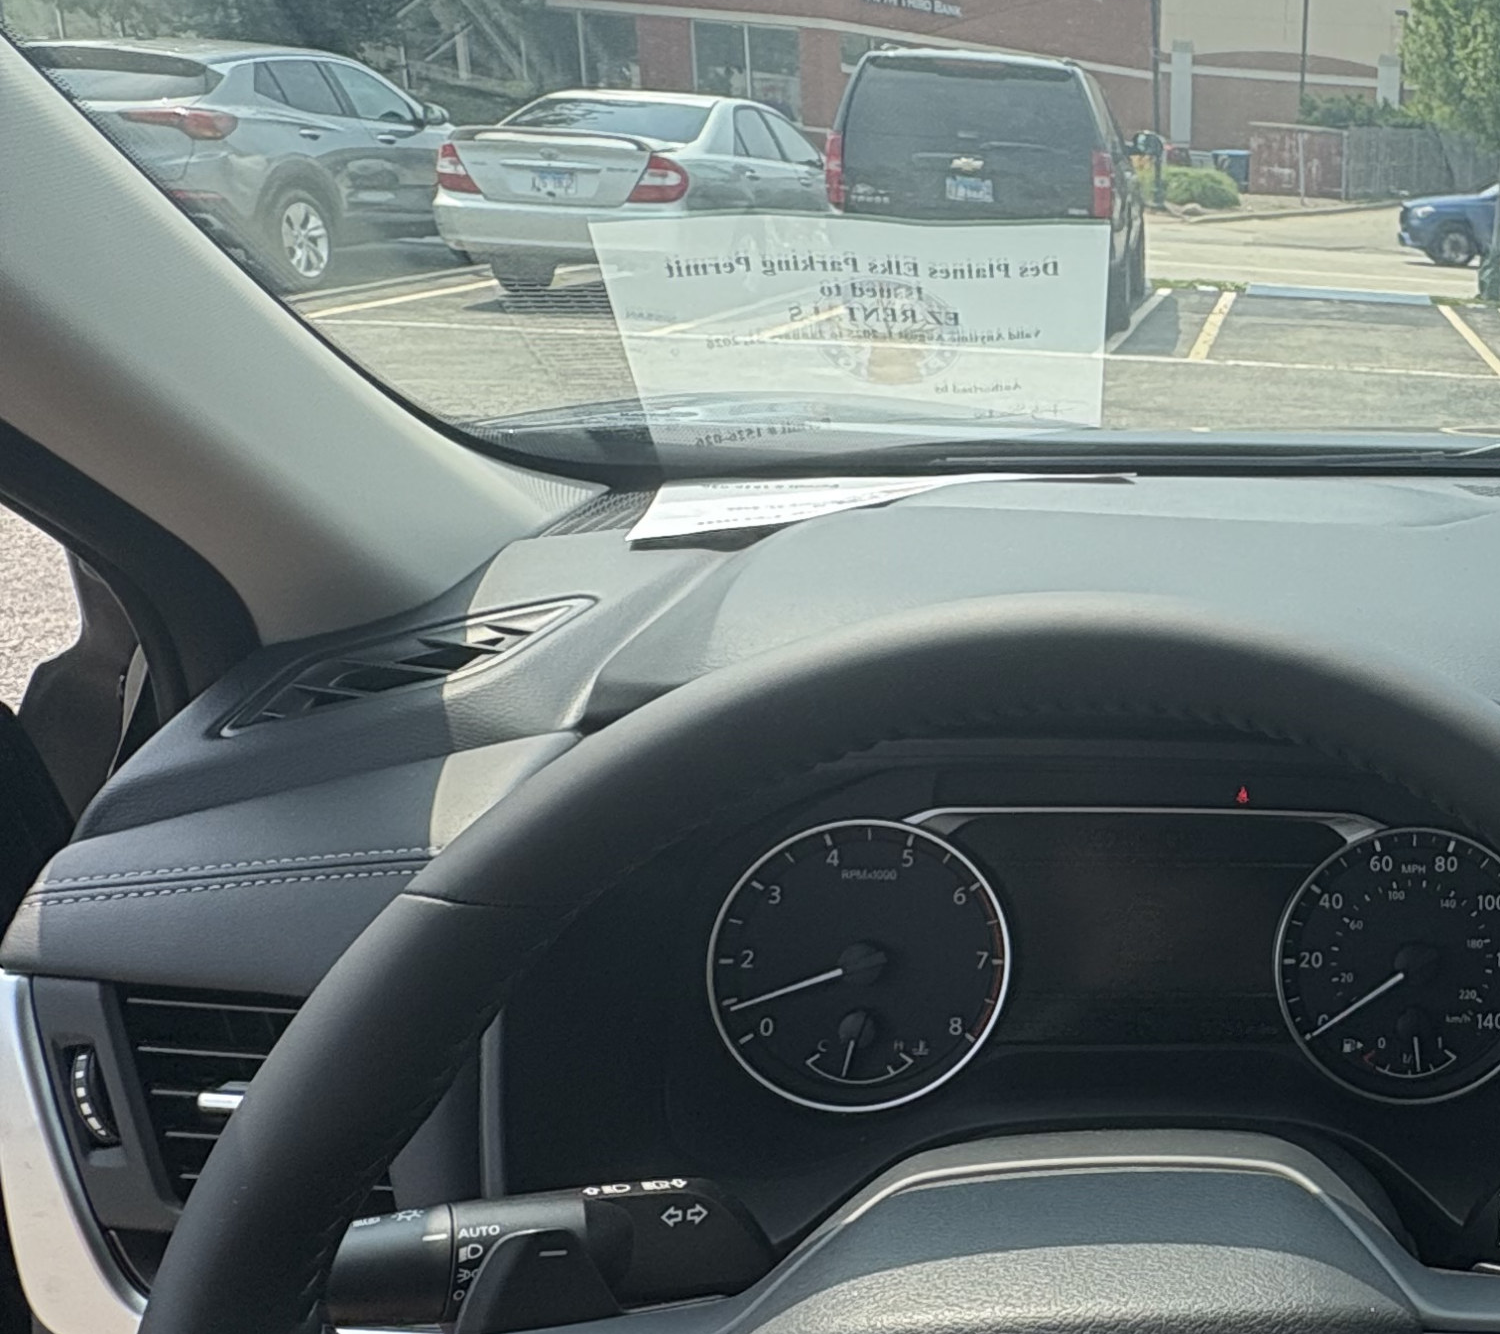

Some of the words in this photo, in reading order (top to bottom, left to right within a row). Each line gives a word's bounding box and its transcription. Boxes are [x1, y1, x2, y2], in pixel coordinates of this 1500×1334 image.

[934, 0, 962, 17] BANK
[826, 849, 839, 867] 4
[901, 849, 914, 867] 5
[1369, 855, 1393, 872] 60
[1434, 856, 1458, 873] 80
[1400, 864, 1426, 875] MPH
[767, 885, 782, 905] 3
[953, 886, 967, 905] 6
[1318, 892, 1343, 910] 40
[1387, 890, 1405, 901] 100
[1440, 898, 1457, 909] 140
[1349, 919, 1363, 930] 60
[1466, 938, 1483, 949] 180
[740, 949, 754, 969] 2
[976, 951, 989, 970] 7
[1299, 951, 1323, 969] 20
[1340, 972, 1354, 983] 20
[1458, 989, 1477, 1000] 220
[760, 1017, 774, 1037] 0
[949, 1016, 963, 1036] 8
[1377, 1037, 1386, 1050] 0
[458, 1224, 500, 1240] AUTO
